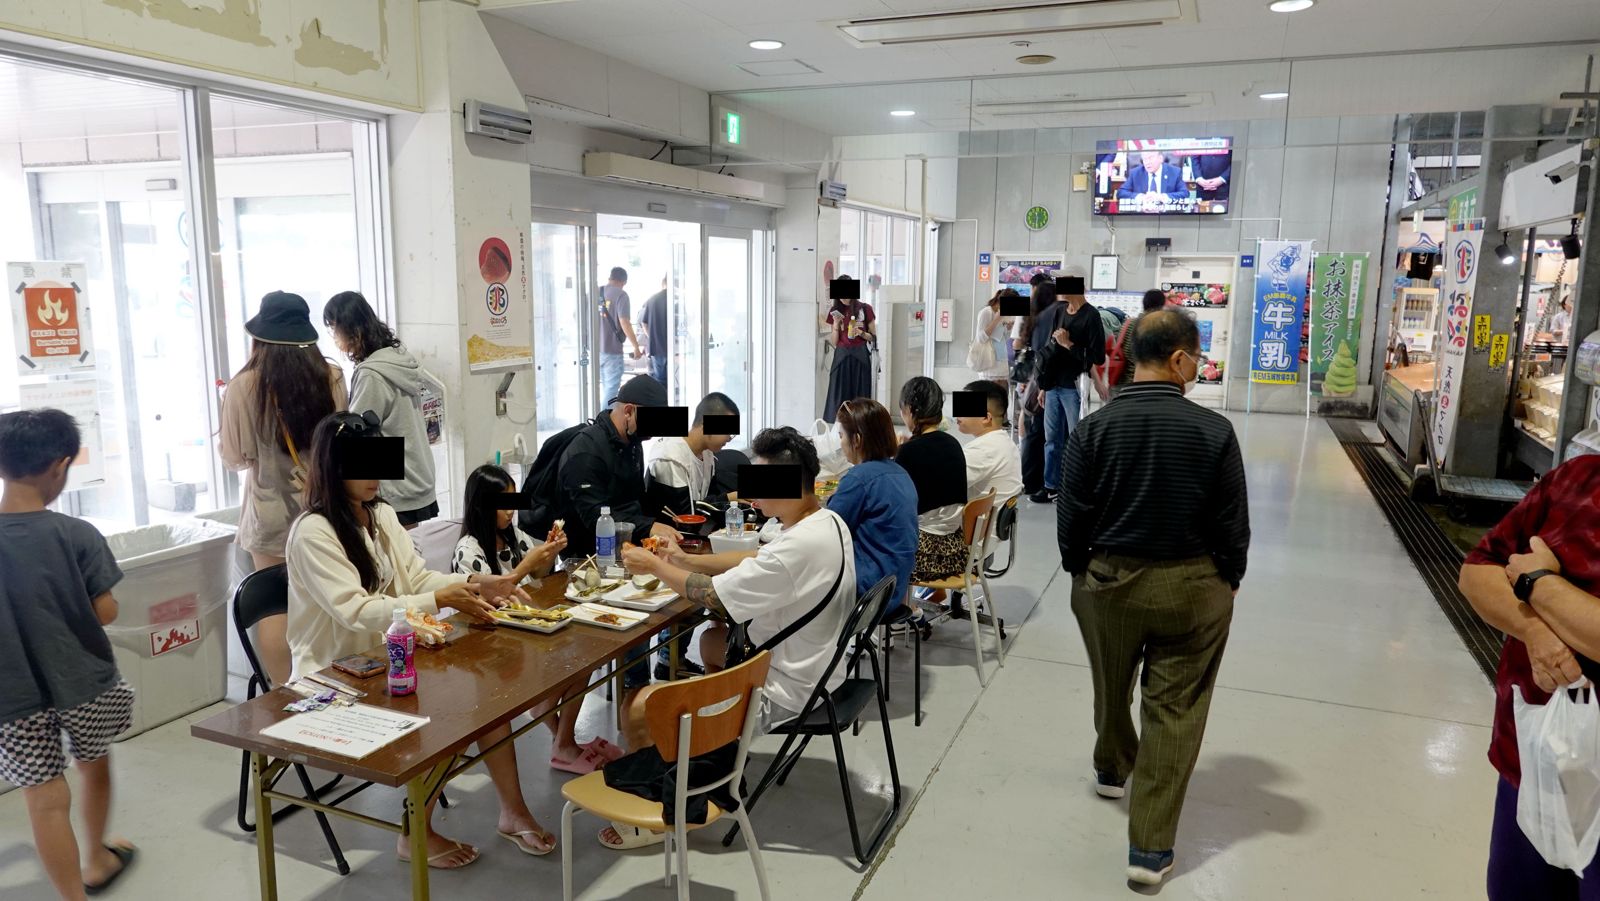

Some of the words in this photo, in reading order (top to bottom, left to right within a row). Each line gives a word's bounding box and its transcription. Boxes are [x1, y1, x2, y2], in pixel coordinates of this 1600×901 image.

[1262, 301, 1295, 331] 牛
[1320, 259, 1346, 362] お抹茶アイス
[1258, 339, 1292, 370] 乳
